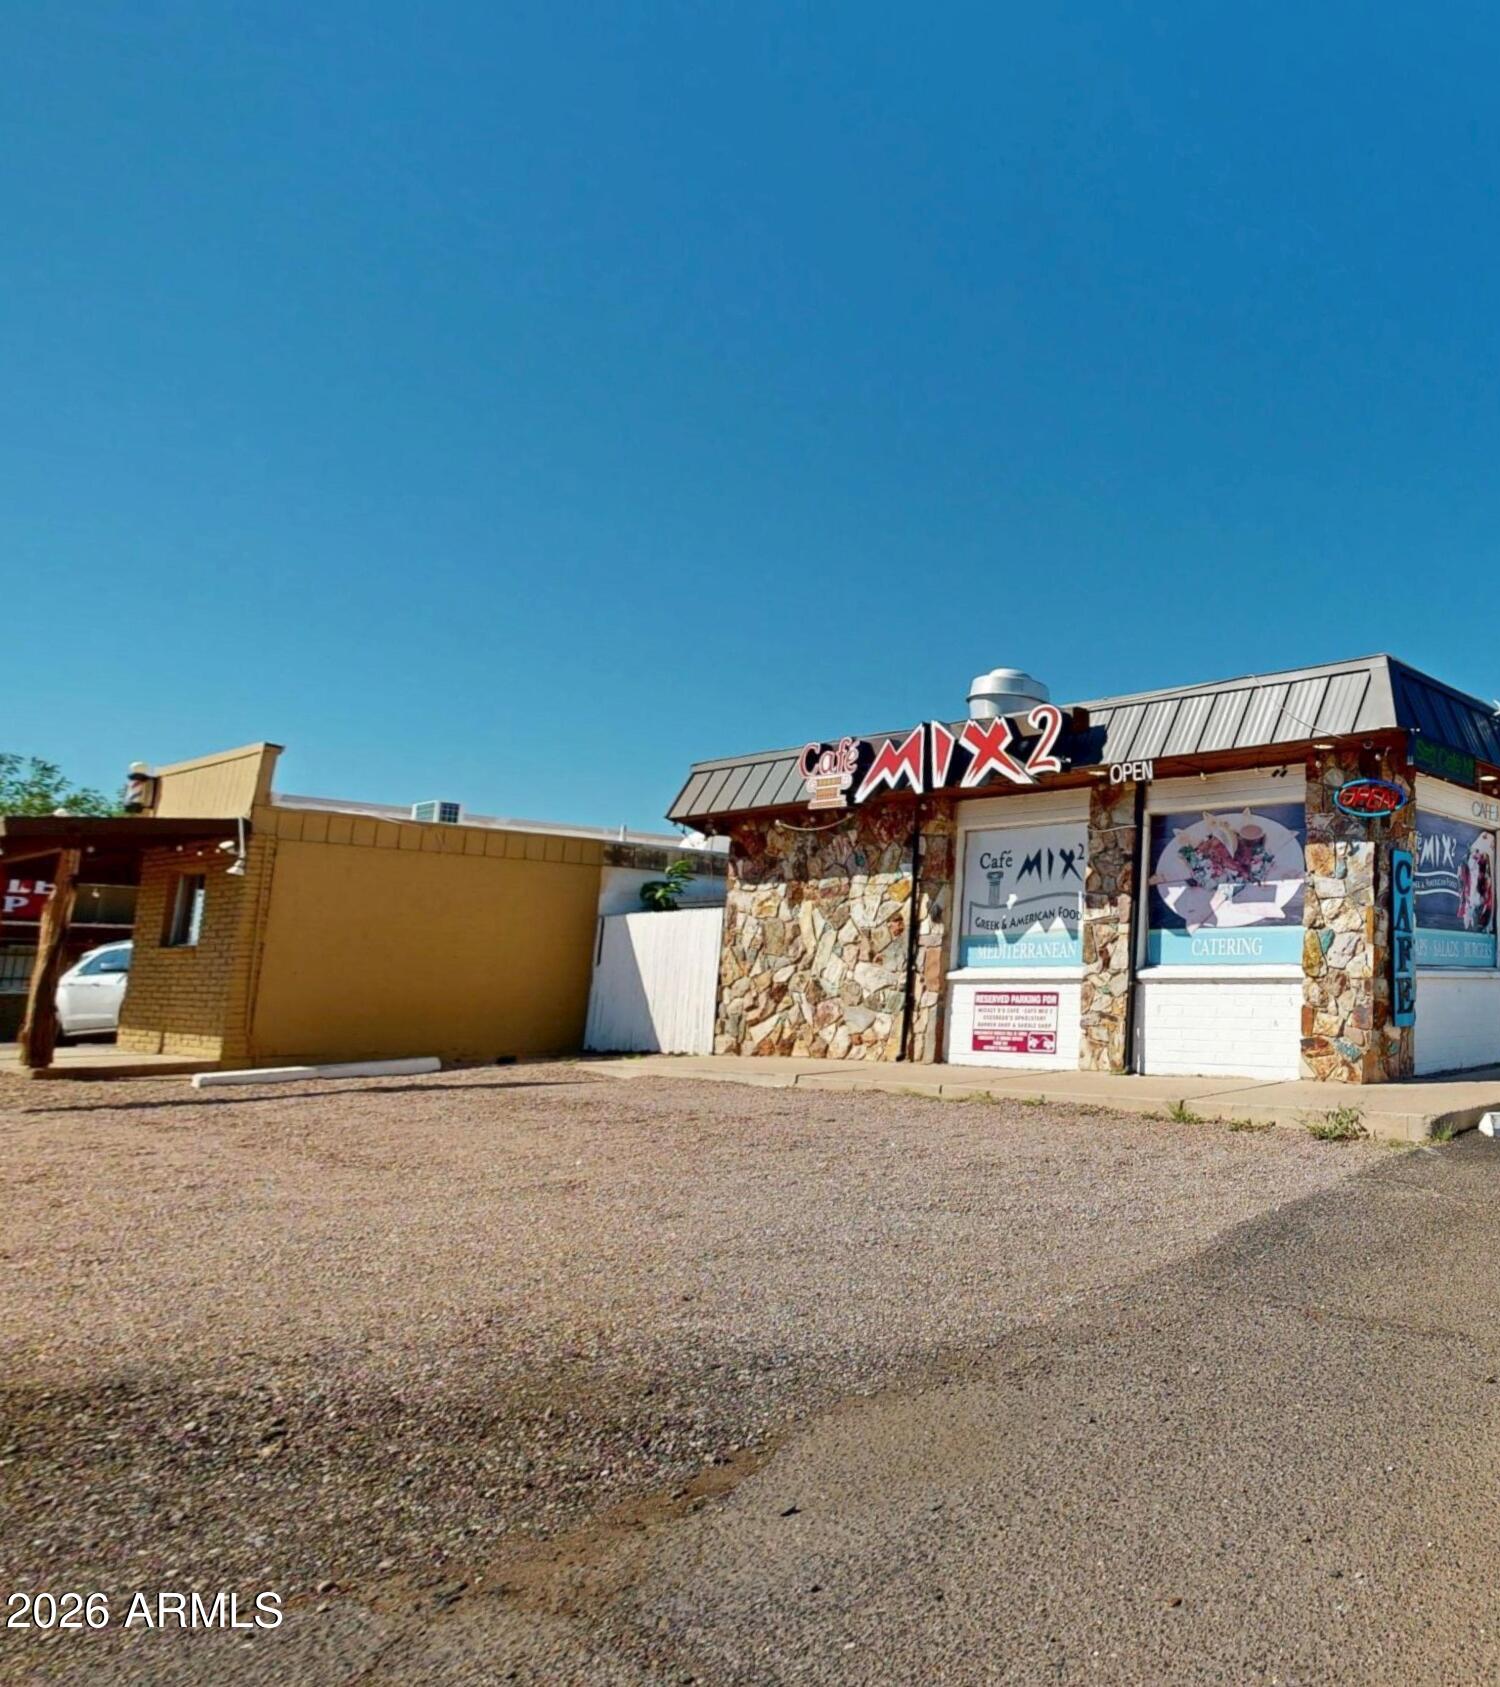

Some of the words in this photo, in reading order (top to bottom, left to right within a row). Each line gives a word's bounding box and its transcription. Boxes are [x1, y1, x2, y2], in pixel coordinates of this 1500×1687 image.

[799, 736, 861, 778] Café
[854, 716, 1039, 803] MIX
[1110, 760, 1154, 784] OPEN
[1339, 787, 1400, 810] OPEN
[980, 850, 1013, 869] Café
[975, 917, 999, 930] GREEK
[1001, 918, 1007, 929] &
[1009, 909, 1055, 928] AMERICAN
[1058, 906, 1082, 920] FOOD
[1191, 937, 1263, 956] CATERING
[1395, 860, 1412, 1014] CAFE
[977, 940, 1078, 960] MEDITERRANEAN
[975, 994, 1010, 1004] RESERVED
[1011, 994, 1041, 1004] PARKING
[1043, 995, 1057, 1004] FOR
